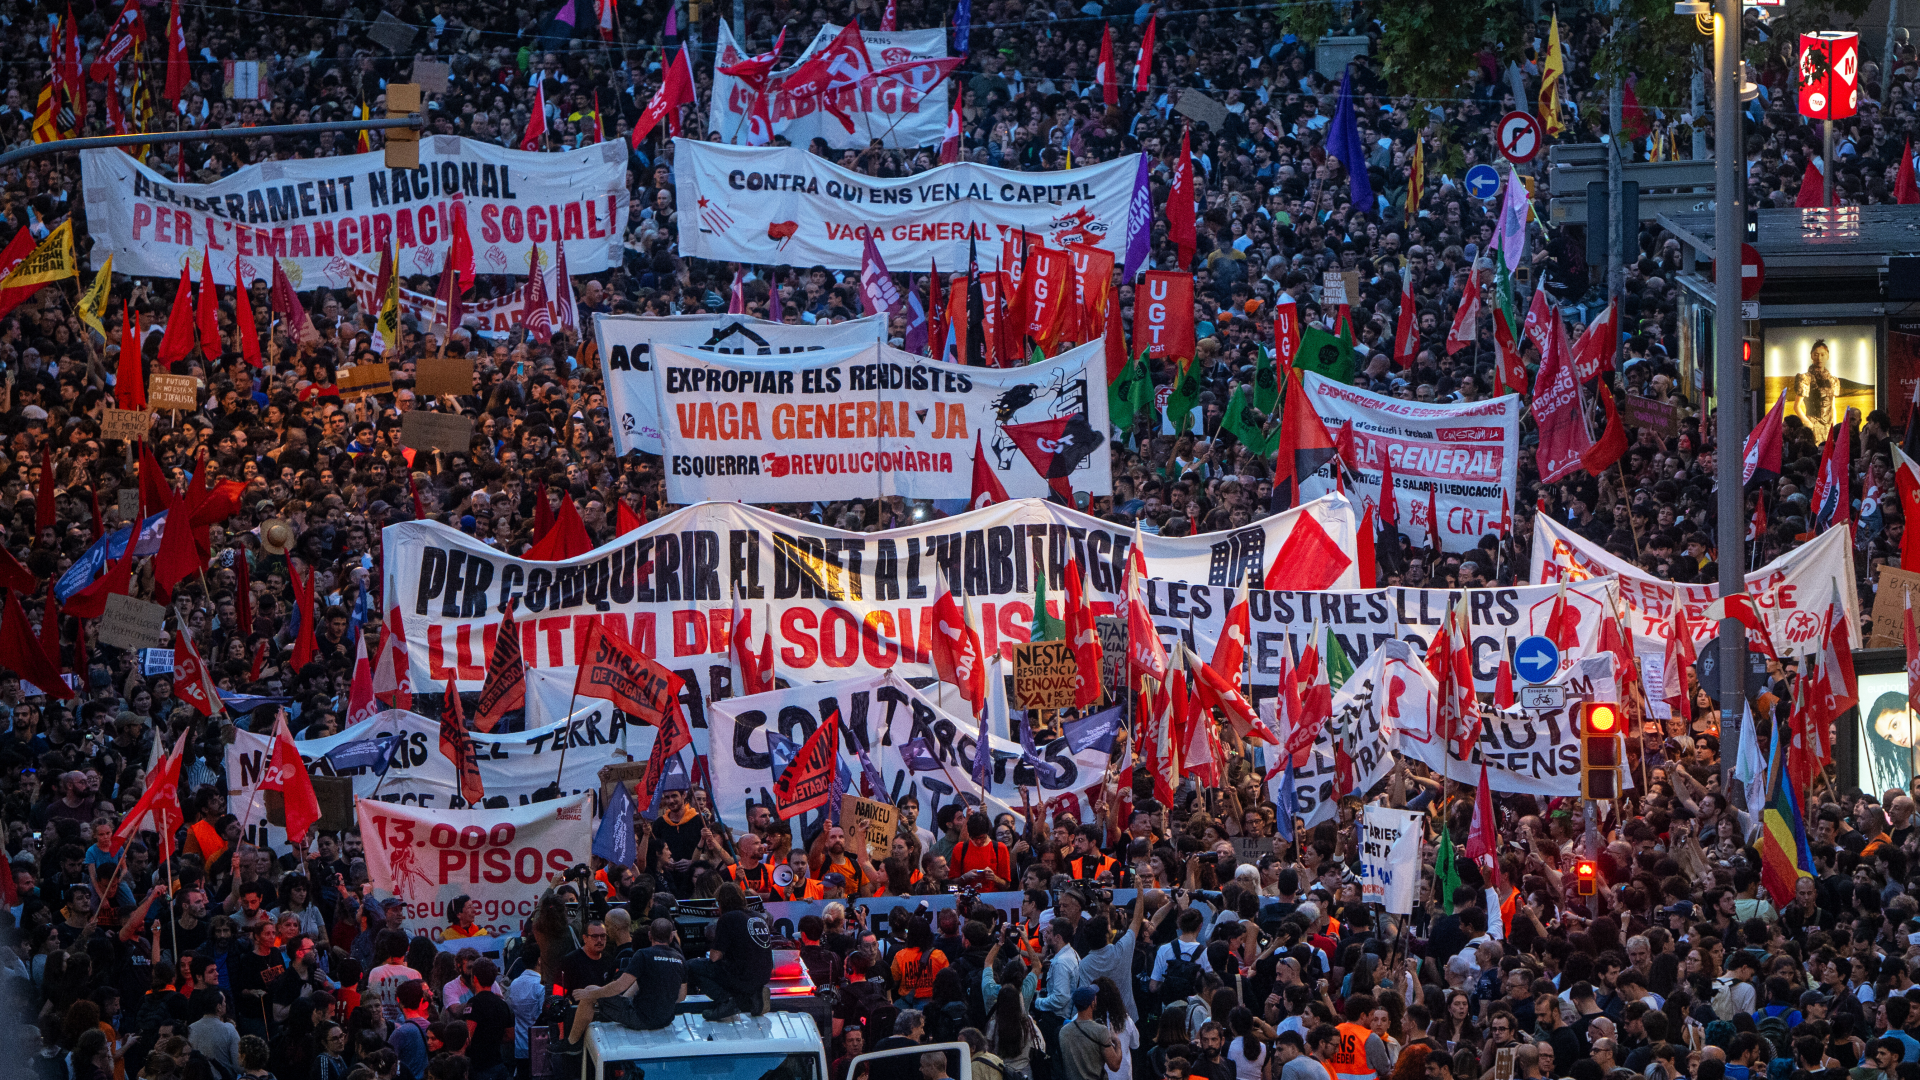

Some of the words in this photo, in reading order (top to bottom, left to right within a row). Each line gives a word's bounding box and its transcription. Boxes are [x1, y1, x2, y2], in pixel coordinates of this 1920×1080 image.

[1844, 57, 1855, 75] M
[368, 161, 516, 206] NACIONAL
[728, 170, 819, 195] CONTRA
[826, 180, 862, 204] QUI
[870, 187, 913, 205] ENS
[919, 182, 960, 203] VEN
[966, 182, 994, 201] AL
[1000, 183, 1096, 203] CAPITAL
[132, 203, 193, 246] PER
[205, 192, 467, 258] L'EMANCIPACIÓ
[481, 194, 617, 244] SOCIAL!
[825, 221, 886, 242] VAGA
[892, 222, 992, 242] GENERAL
[1034, 254, 1050, 321] UGT
[1148, 279, 1167, 343] UGT
[666, 366, 794, 394] EXPROPIAR
[802, 367, 842, 394] ELS
[850, 363, 973, 394] RENDISTES
[109, 410, 147, 423] TECHO
[676, 401, 762, 441] VAGA
[772, 400, 915, 441] GENERAL
[931, 402, 969, 440] JA
[672, 454, 760, 478] ESQUERRA
[791, 445, 953, 475] REVOLUCIONÀRIA
[1387, 443, 1498, 477] GENERAL
[1447, 505, 1488, 536] CRT
[415, 546, 495, 619] PER
[497, 530, 720, 615] CONQUERIR
[730, 529, 765, 602] EL
[773, 530, 867, 603] DRET
[876, 538, 900, 601] A
[905, 523, 1131, 600] L'HABITATGE
[1687, 570, 1787, 603] LLTA
[1147, 578, 1212, 620] LES
[1396, 589, 1520, 627] LLRS
[1016, 643, 1078, 669] NESTA
[1017, 665, 1077, 678] RESIDENCIA
[1017, 677, 1076, 693] RENOVAC
[1017, 692, 1052, 709] YA!
[1054, 690, 1066, 698] DE
[372, 815, 516, 850] 13.000
[438, 847, 574, 885] PISOS
[407, 901, 445, 920] seu
[471, 895, 540, 922] egoci
